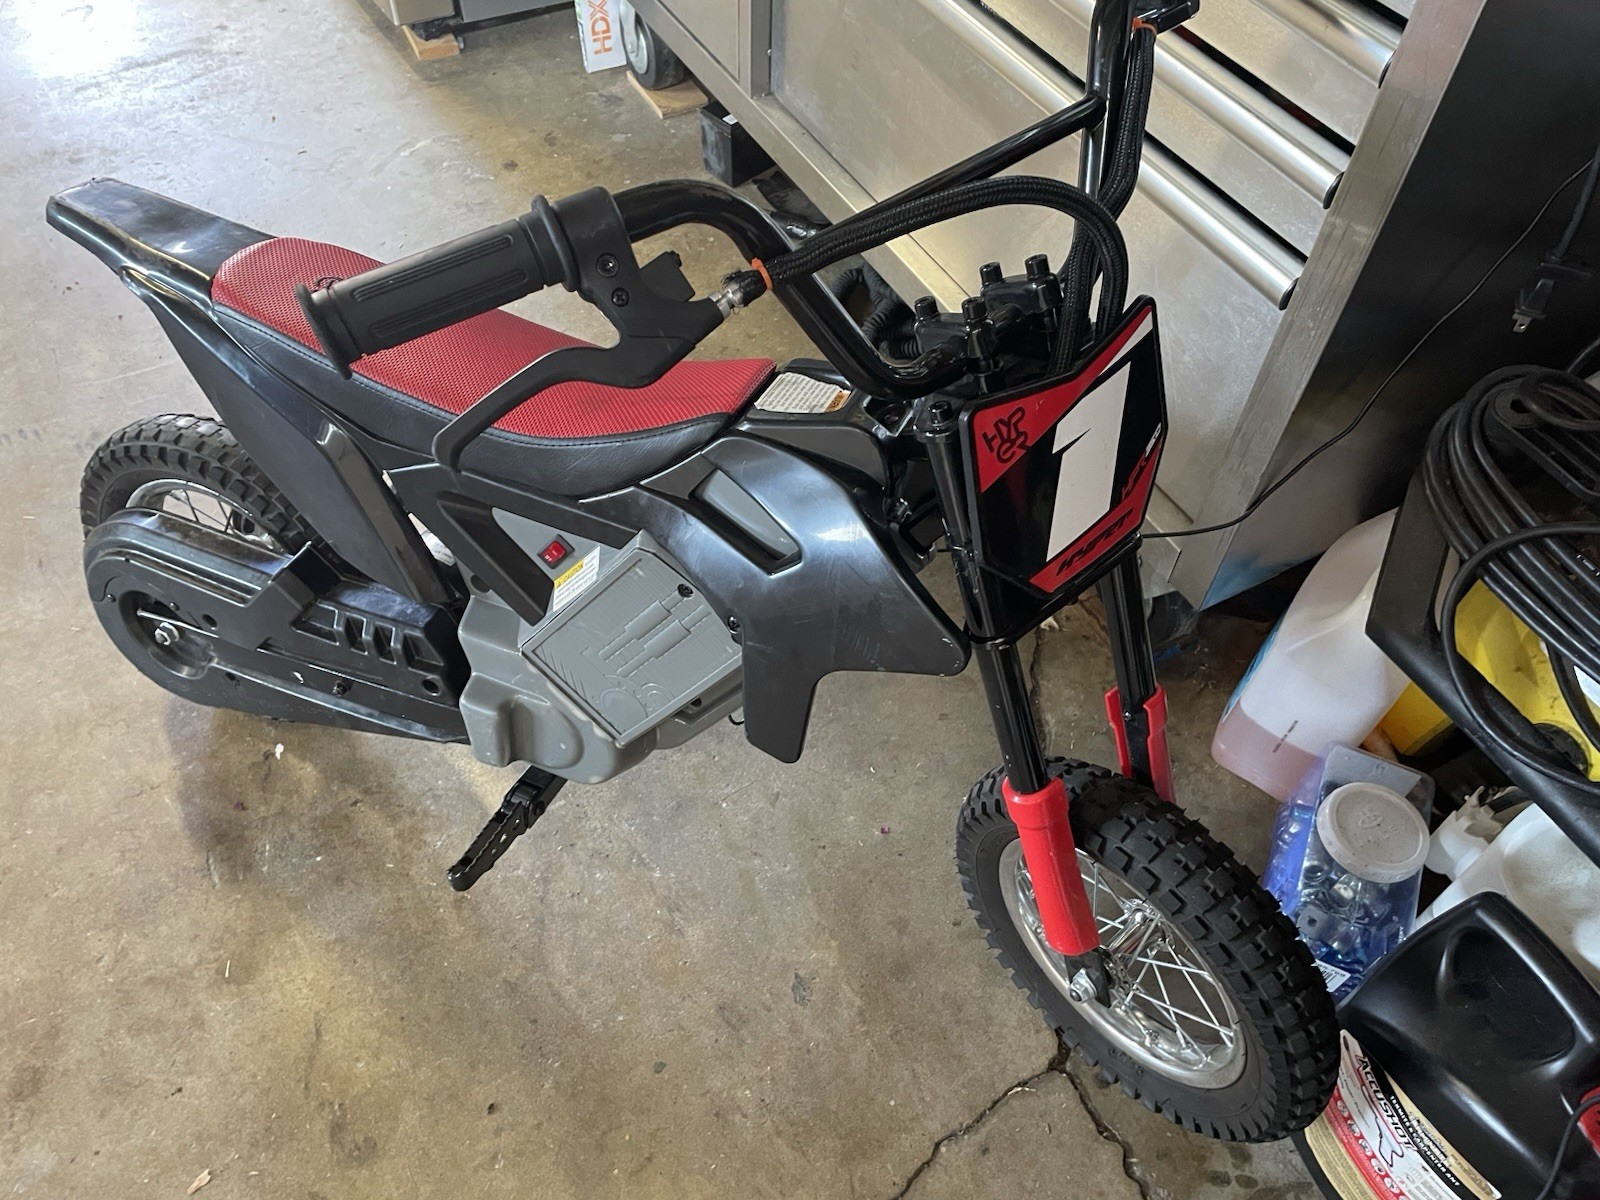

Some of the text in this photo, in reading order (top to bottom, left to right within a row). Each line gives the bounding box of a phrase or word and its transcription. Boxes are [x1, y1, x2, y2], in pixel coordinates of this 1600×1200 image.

[588, 0, 613, 55] HDX
[1046, 360, 1132, 563] 1
[1358, 1056, 1416, 1149] ACCUSHOT
[1445, 1172, 1461, 1187] ANT
